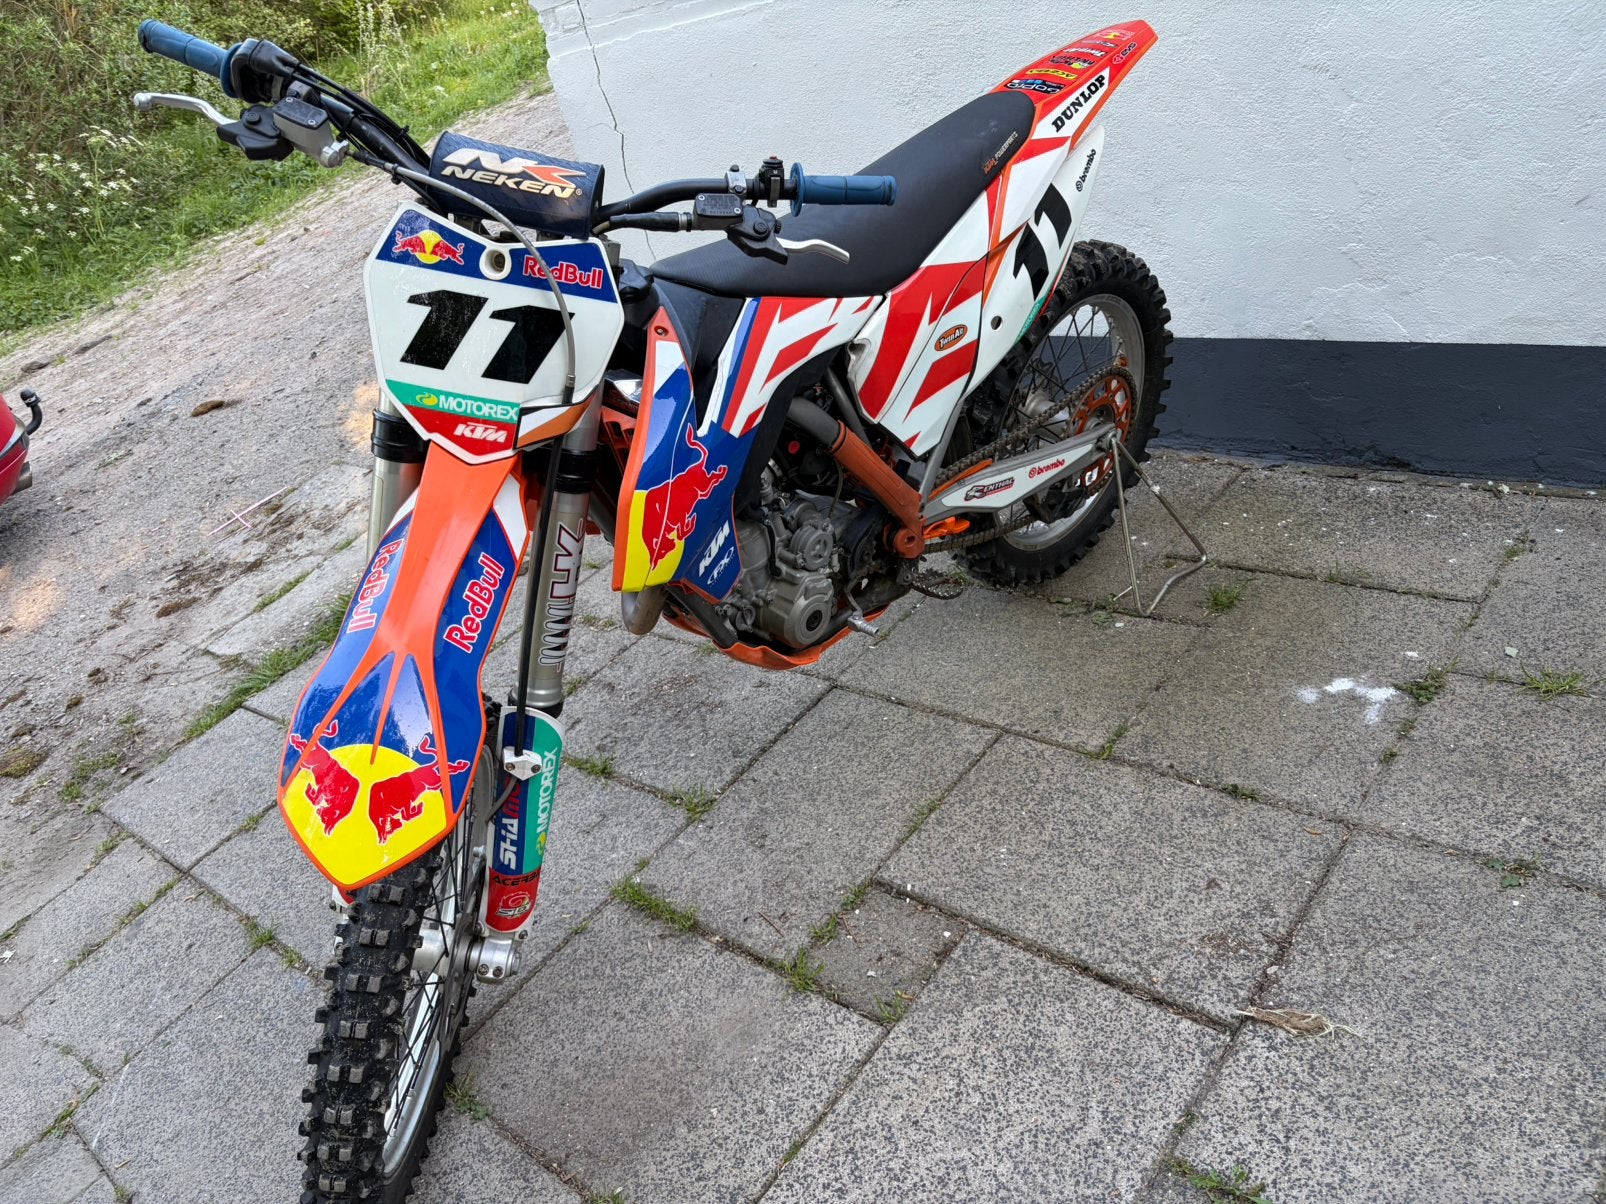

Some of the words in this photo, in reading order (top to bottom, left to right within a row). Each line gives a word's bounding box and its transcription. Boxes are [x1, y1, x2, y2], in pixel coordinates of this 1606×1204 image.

[1007, 82, 1061, 94] GoPro
[1051, 74, 1106, 133] DUNLOP
[441, 165, 576, 198] NEKEN
[1080, 149, 1097, 183] brembo
[399, 289, 576, 384] 11
[439, 395, 519, 420] MOTOREX
[453, 421, 508, 443] KTM
[1036, 459, 1065, 476] brembo
[698, 520, 730, 577] KTM
[443, 552, 505, 654] RedBull
[536, 747, 558, 833] MOTOREX
